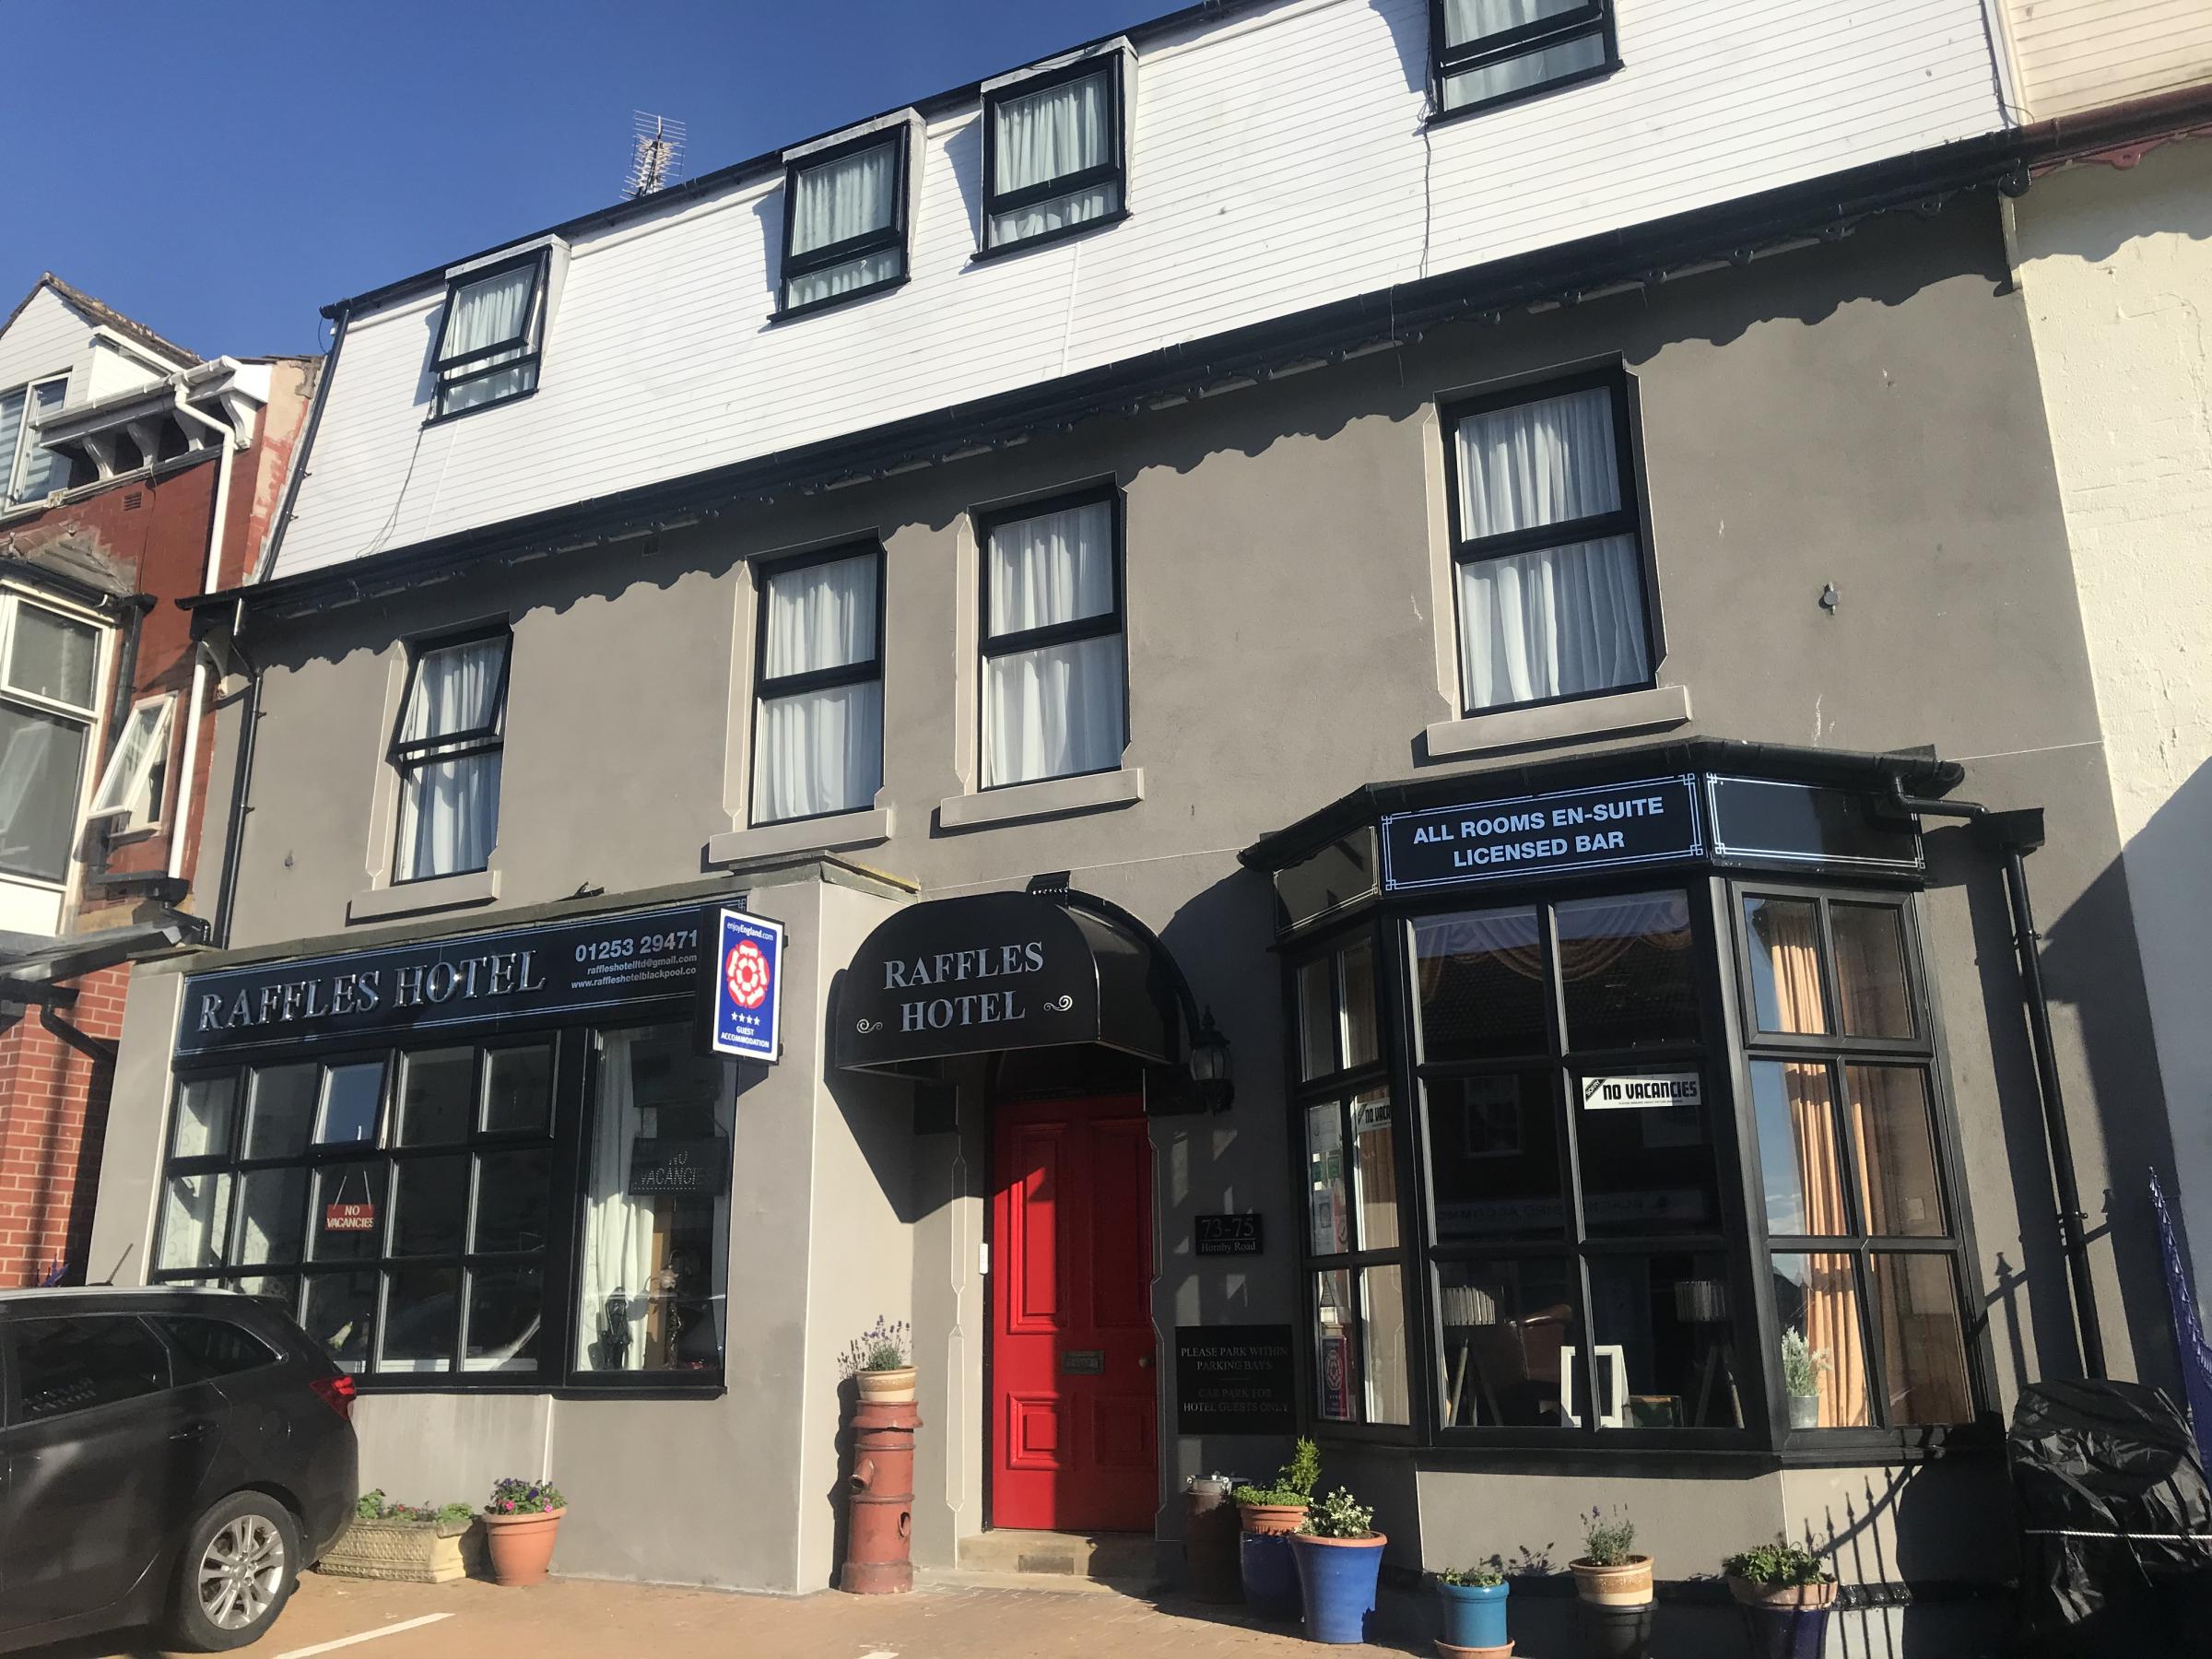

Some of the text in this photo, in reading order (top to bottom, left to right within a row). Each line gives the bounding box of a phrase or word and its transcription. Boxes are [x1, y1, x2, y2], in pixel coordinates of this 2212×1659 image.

[1413, 796, 1665, 845] ALL ROOMS EN-SUITE
[1453, 830, 1626, 868] LICENSED BAR
[726, 922, 774, 942] enjoyEngland.com
[575, 929, 699, 963] 01253 29471
[587, 954, 699, 975] raffleshotelltd@gmail.com
[883, 940, 1044, 990] RAFFLES
[197, 950, 547, 1032] RAFFLES HOTEL
[899, 990, 1027, 1032] HOTEL
[721, 1031, 770, 1049] ACCOMMODATION
[735, 1025, 755, 1036] GUEST
[1603, 1081, 1698, 1100] NO VACANCIES
[345, 1205, 360, 1216] NO
[326, 1217, 375, 1228] VACANCIES
[1201, 1217, 1254, 1239] 73-75
[1201, 1241, 1256, 1253] Hornby Road
[1180, 1346, 1289, 1358] PLEASE PARK WITHIN
[1196, 1360, 1275, 1371] PARKING BAYS
[1182, 1402, 1217, 1413] HOTEL
[1218, 1402, 1258, 1413] GUESTS
